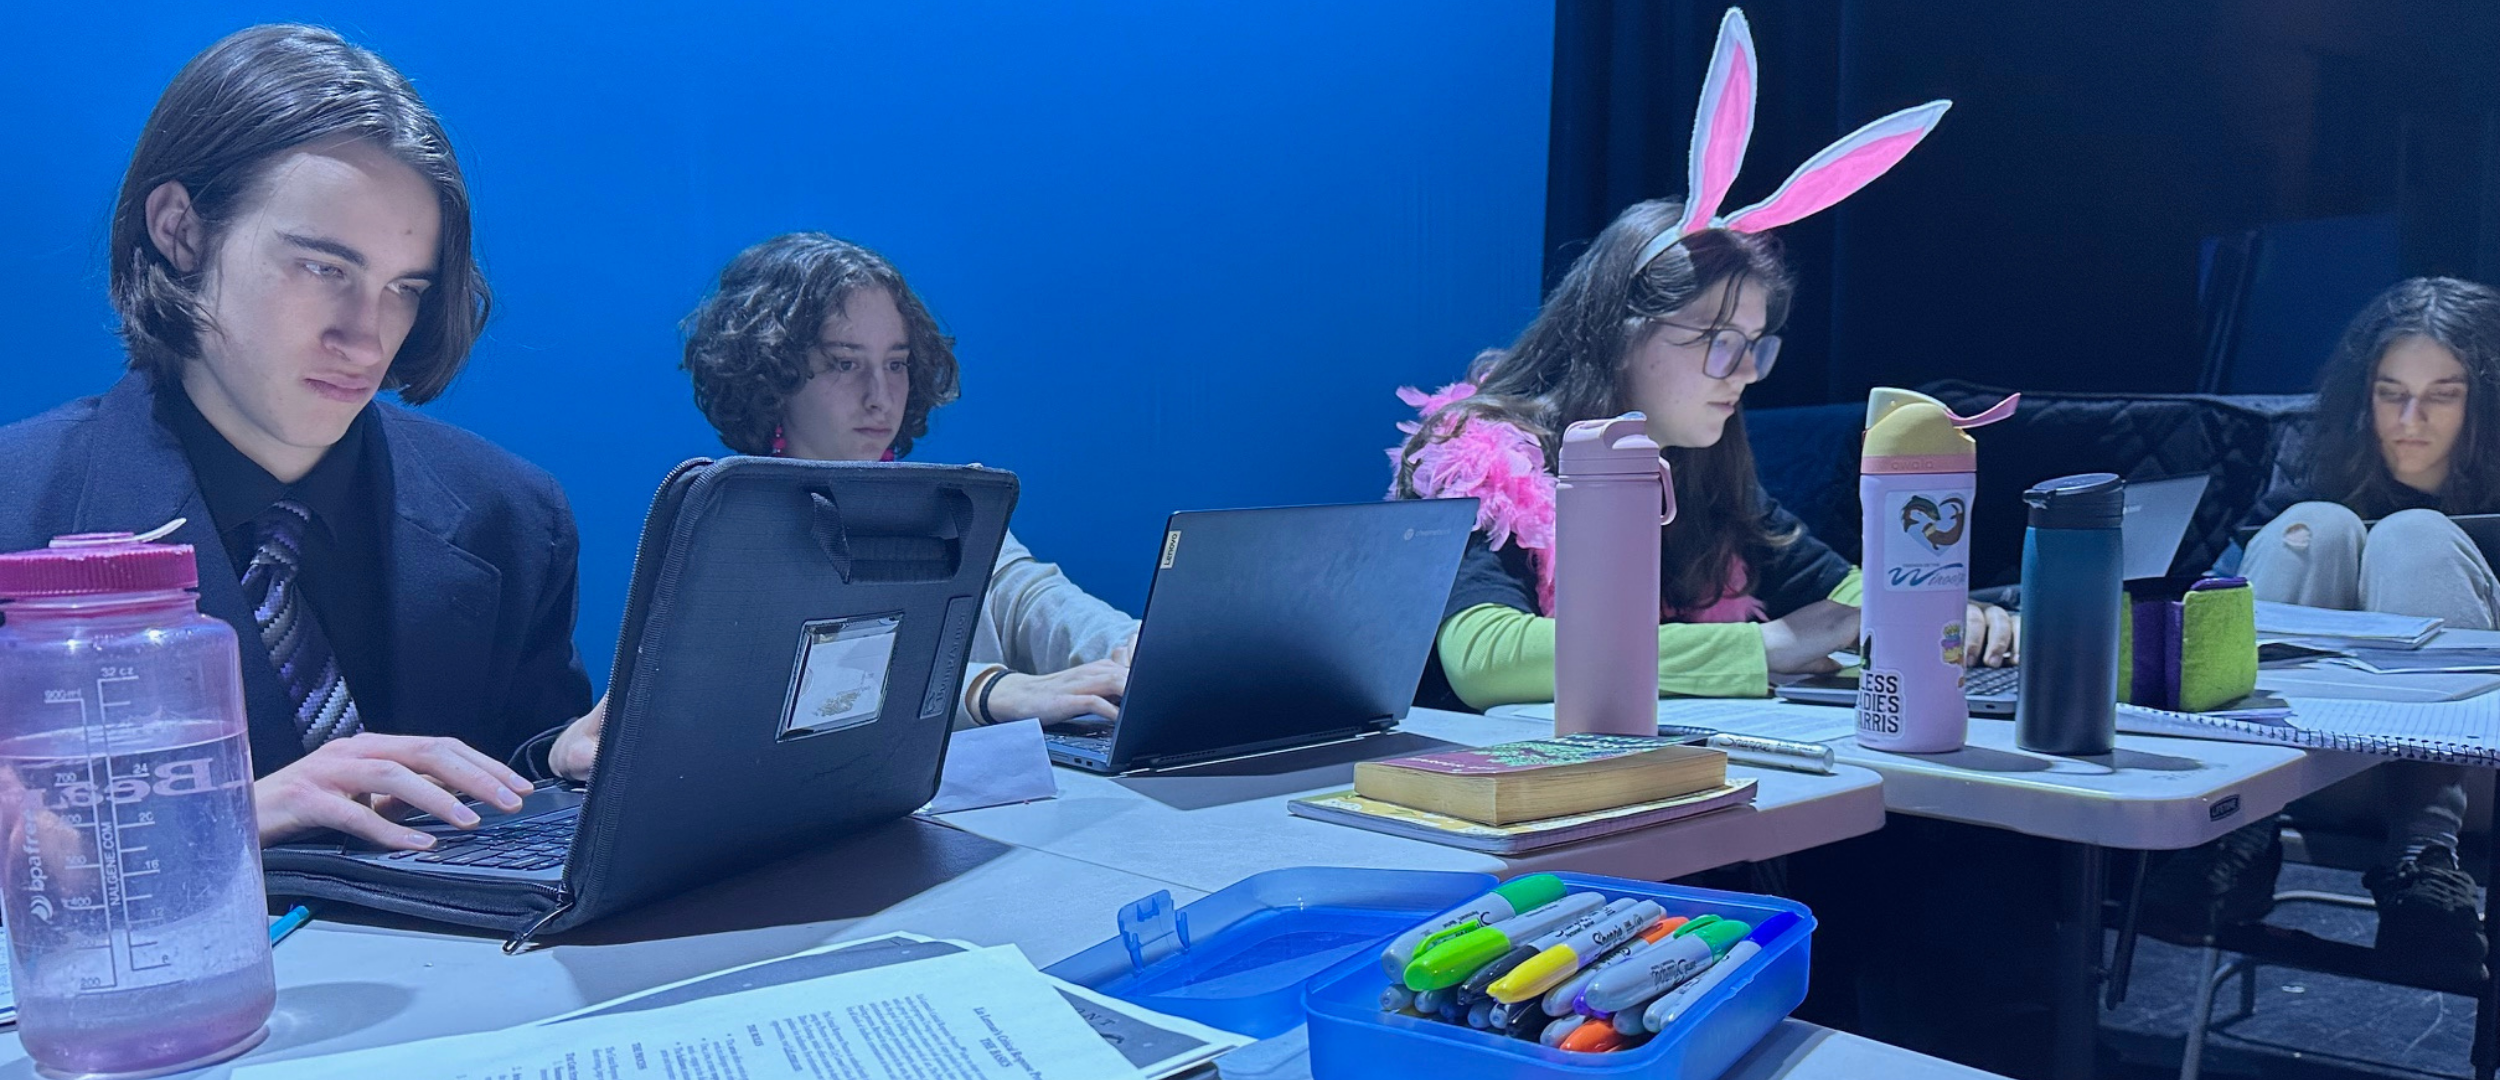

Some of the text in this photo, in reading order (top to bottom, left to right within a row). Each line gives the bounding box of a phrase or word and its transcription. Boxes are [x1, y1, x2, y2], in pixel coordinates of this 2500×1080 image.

[1163, 533, 1178, 566] Lenovo
[101, 667, 115, 677] 32
[133, 763, 149, 774] 24
[54, 772, 77, 783] 700
[101, 821, 121, 907] NALGENE.COM
